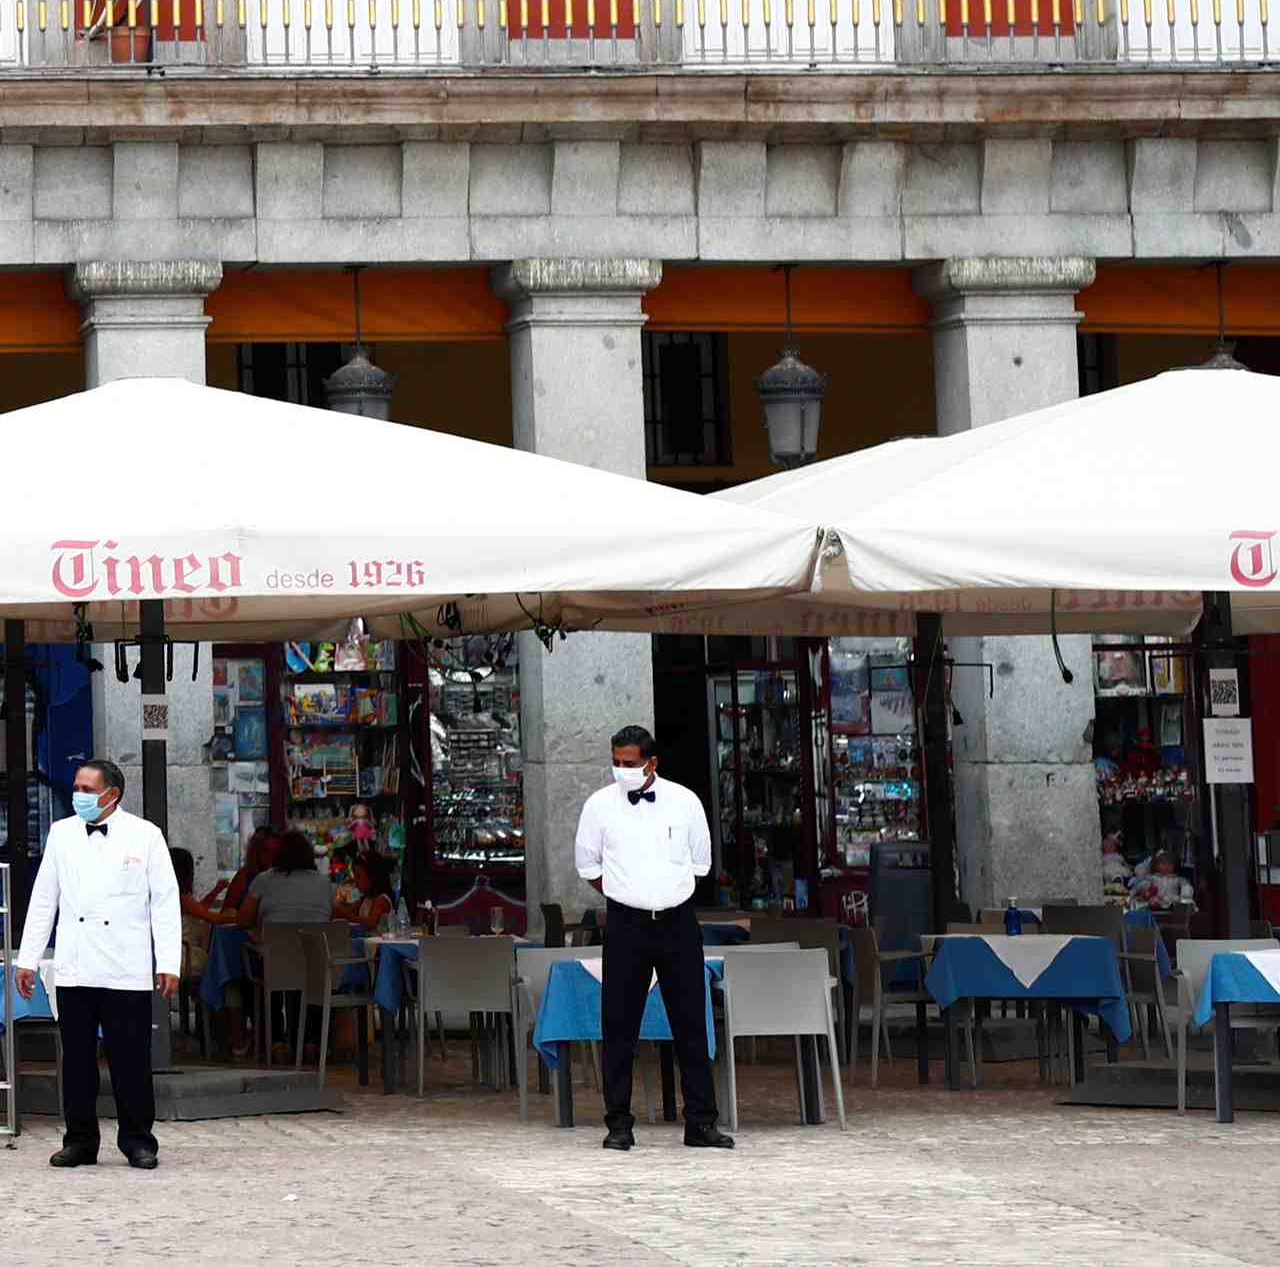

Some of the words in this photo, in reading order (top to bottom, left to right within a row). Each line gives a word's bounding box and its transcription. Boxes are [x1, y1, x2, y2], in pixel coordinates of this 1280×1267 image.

[49, 539, 244, 598] Tineo
[265, 568, 336, 590] desde
[349, 559, 427, 589] 1926
